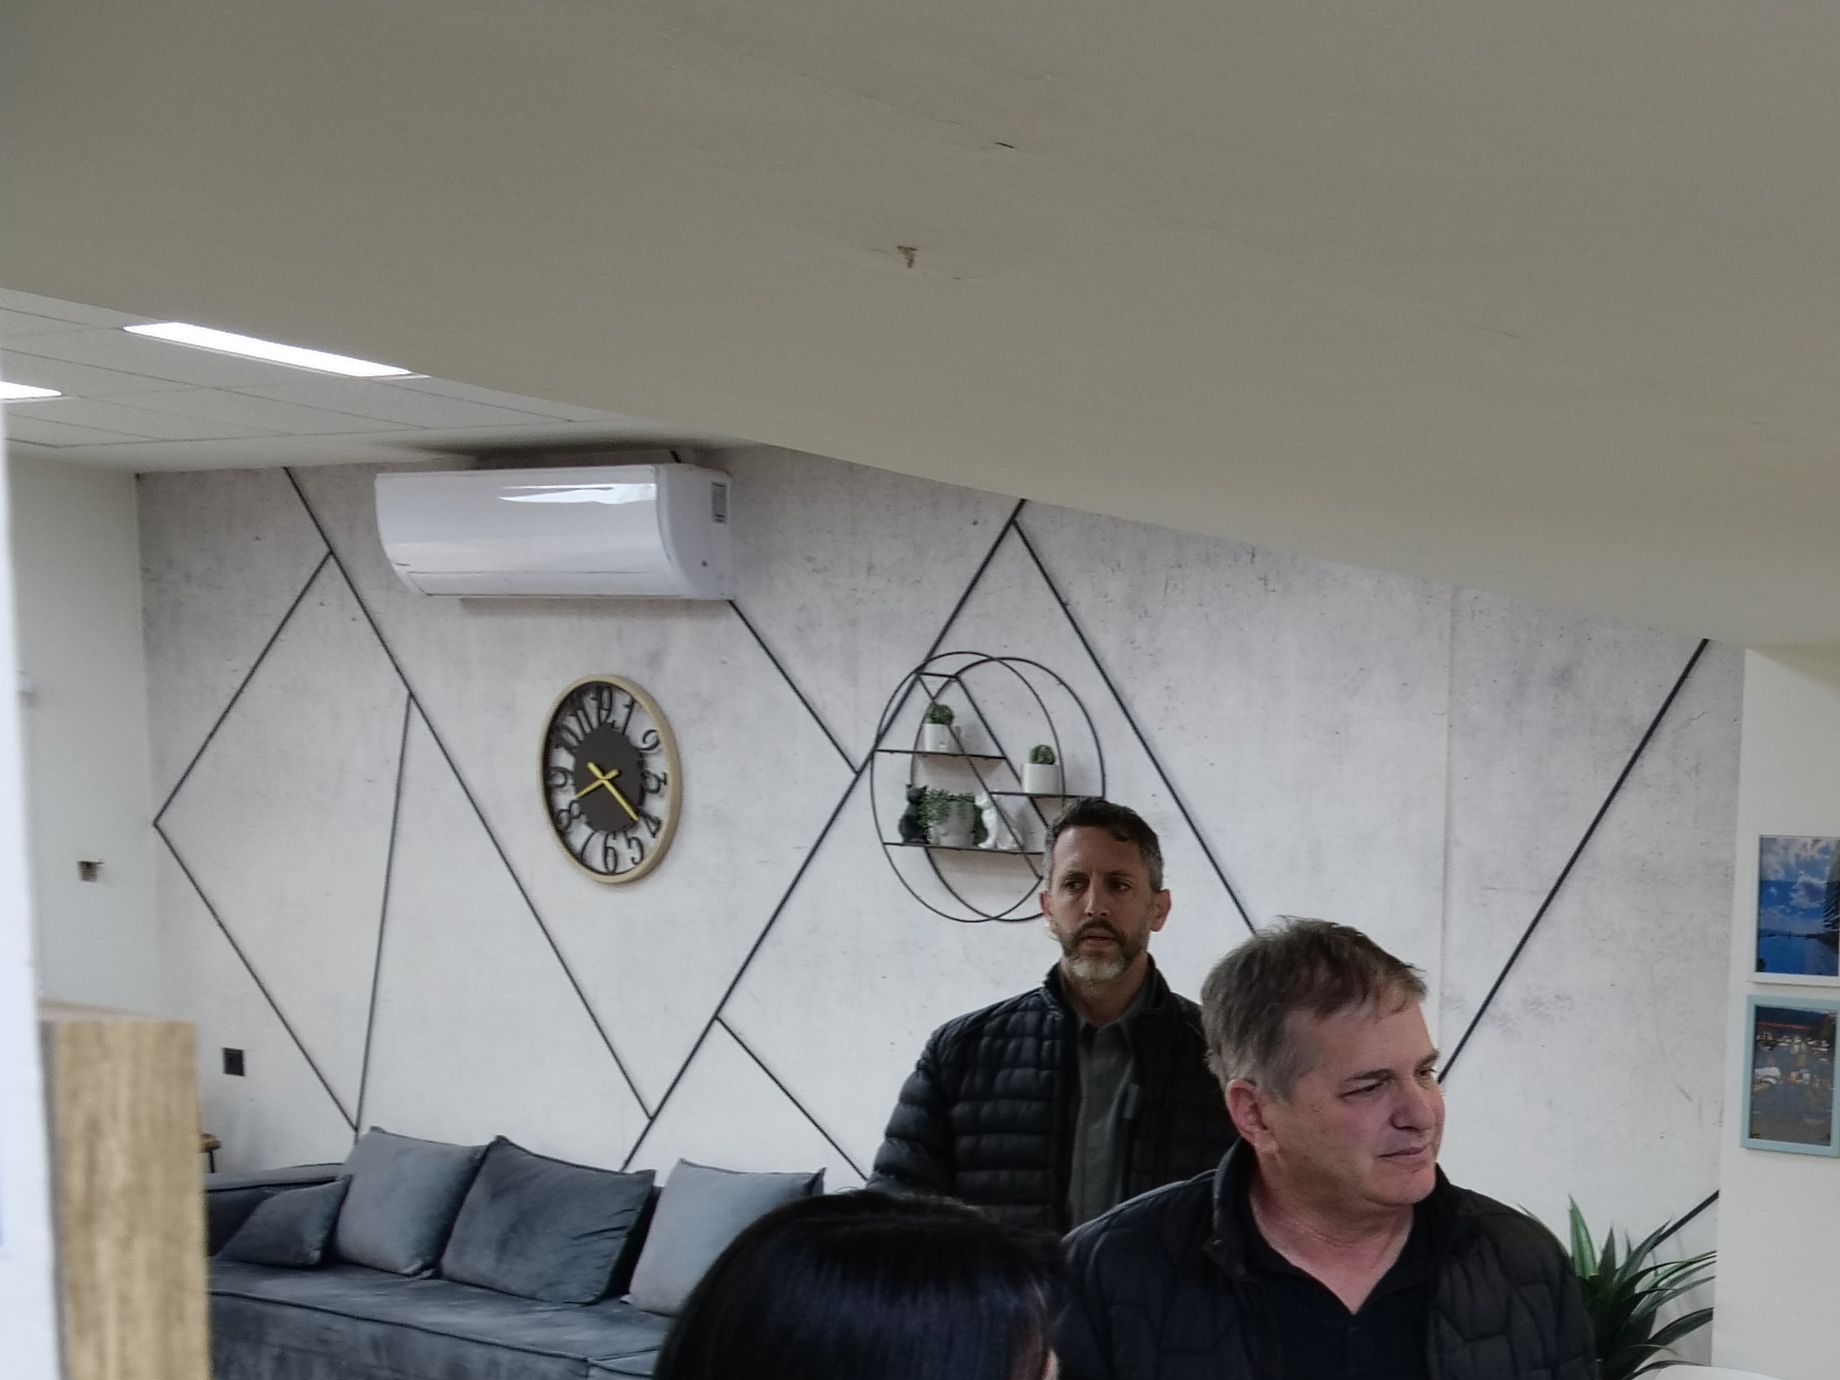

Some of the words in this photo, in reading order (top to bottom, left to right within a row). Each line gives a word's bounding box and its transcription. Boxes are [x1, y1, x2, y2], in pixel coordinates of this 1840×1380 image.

[623, 697, 636, 736] 1
[557, 799, 581, 832] 8
[604, 829, 618, 874] 6
[622, 828, 644, 865] 5
